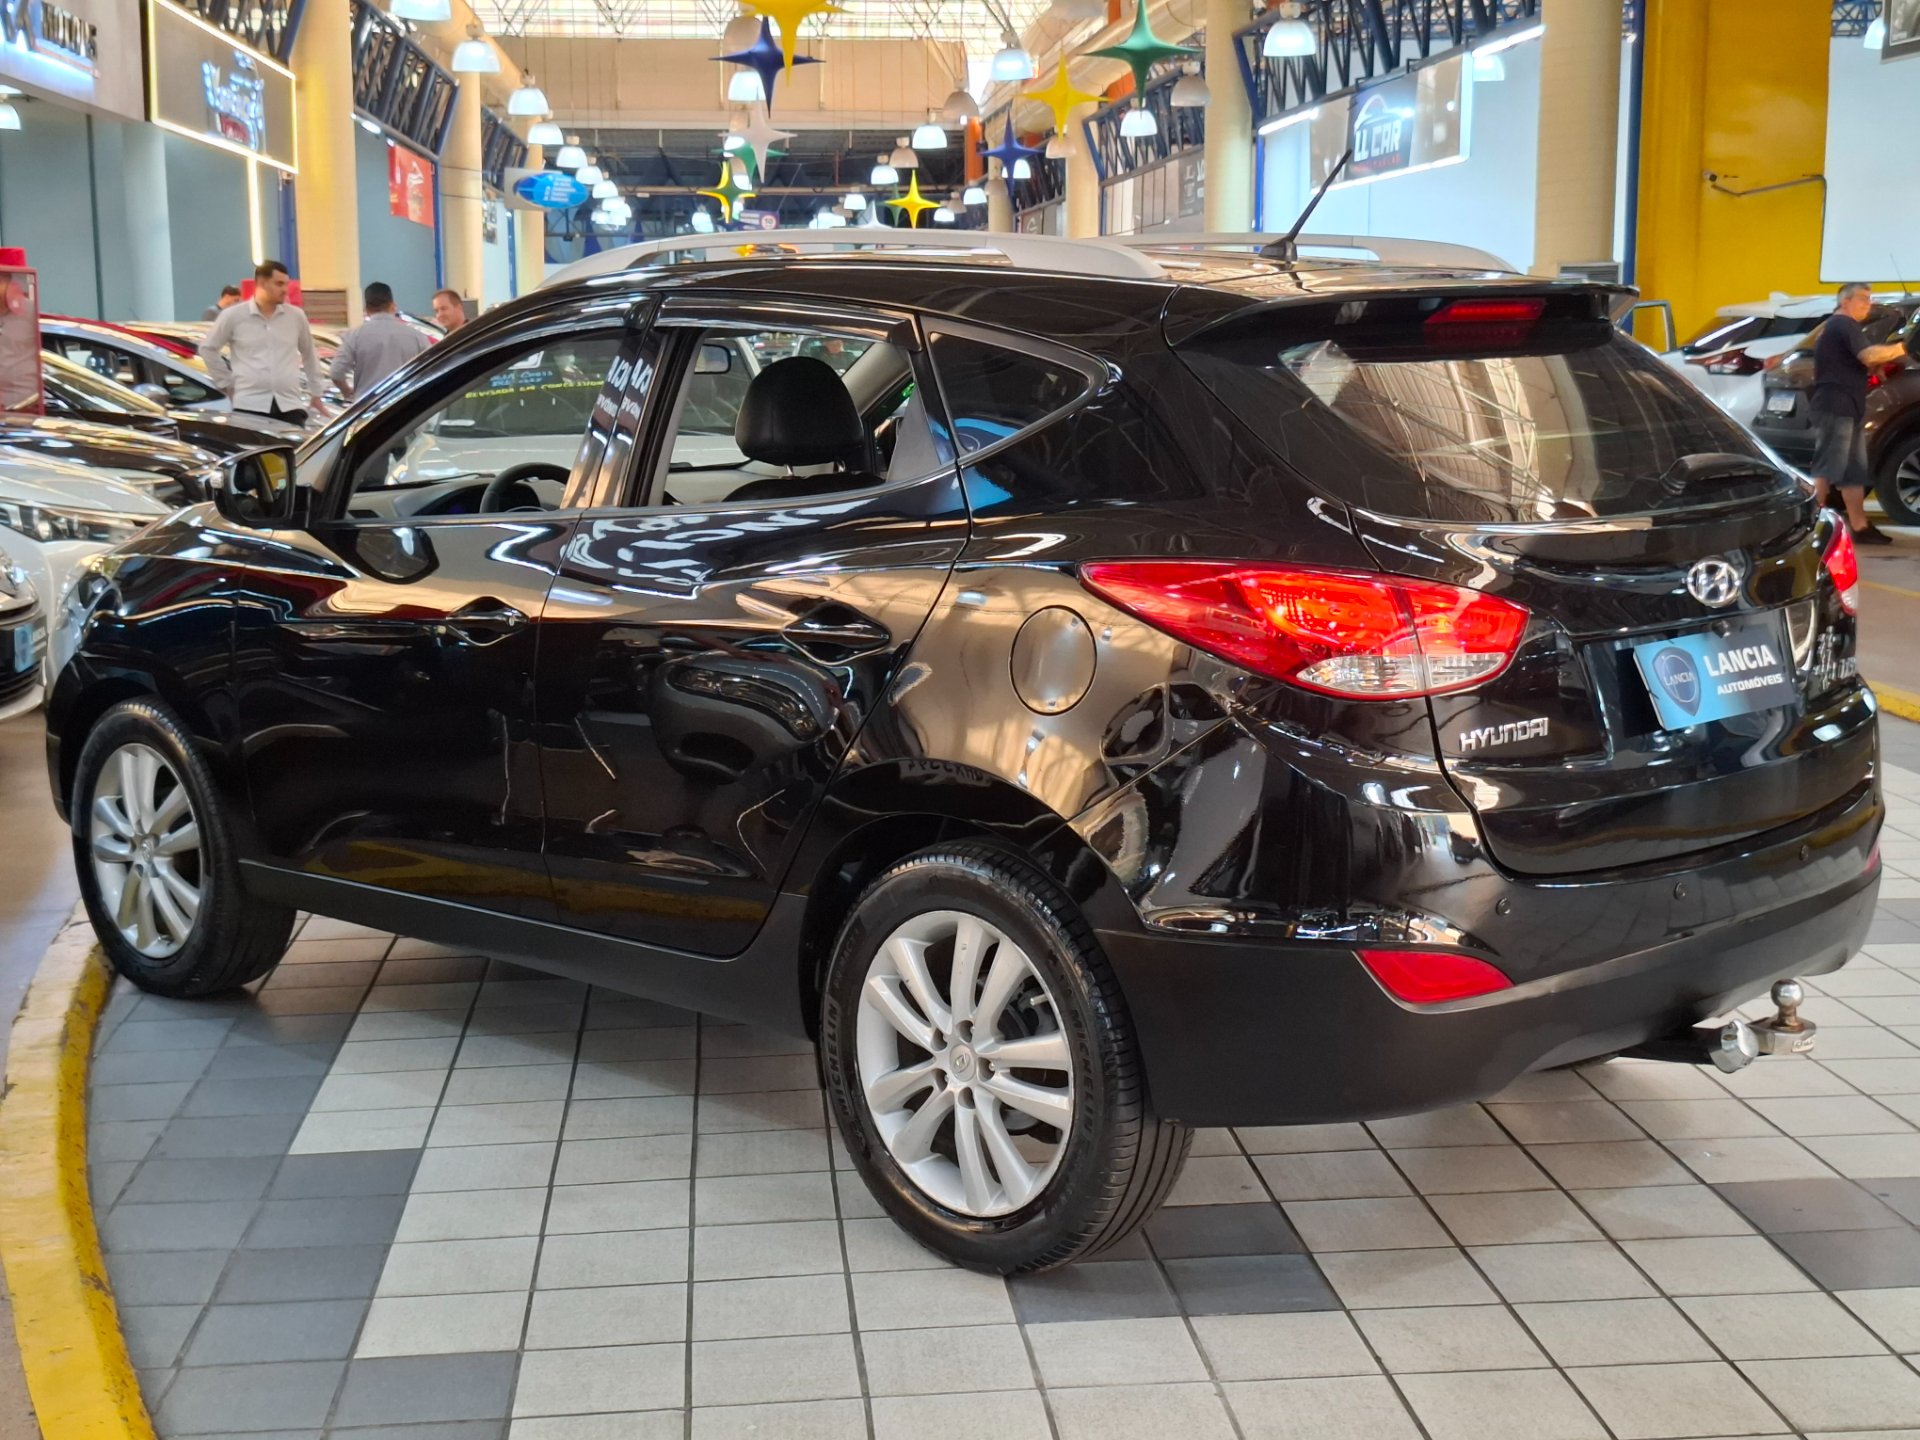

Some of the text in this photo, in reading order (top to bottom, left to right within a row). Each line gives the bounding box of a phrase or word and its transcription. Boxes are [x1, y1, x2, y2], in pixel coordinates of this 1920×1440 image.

[1370, 119, 1402, 157] CAR
[1663, 671, 1696, 686] LANCIA
[1703, 644, 1777, 677] LANCIA
[1717, 673, 1784, 696] AUTOMÓVEIS
[1459, 716, 1550, 753] HYUNDAI
[825, 1002, 850, 1117] MICHELIN
[1070, 1008, 1095, 1134] MICHELIN
